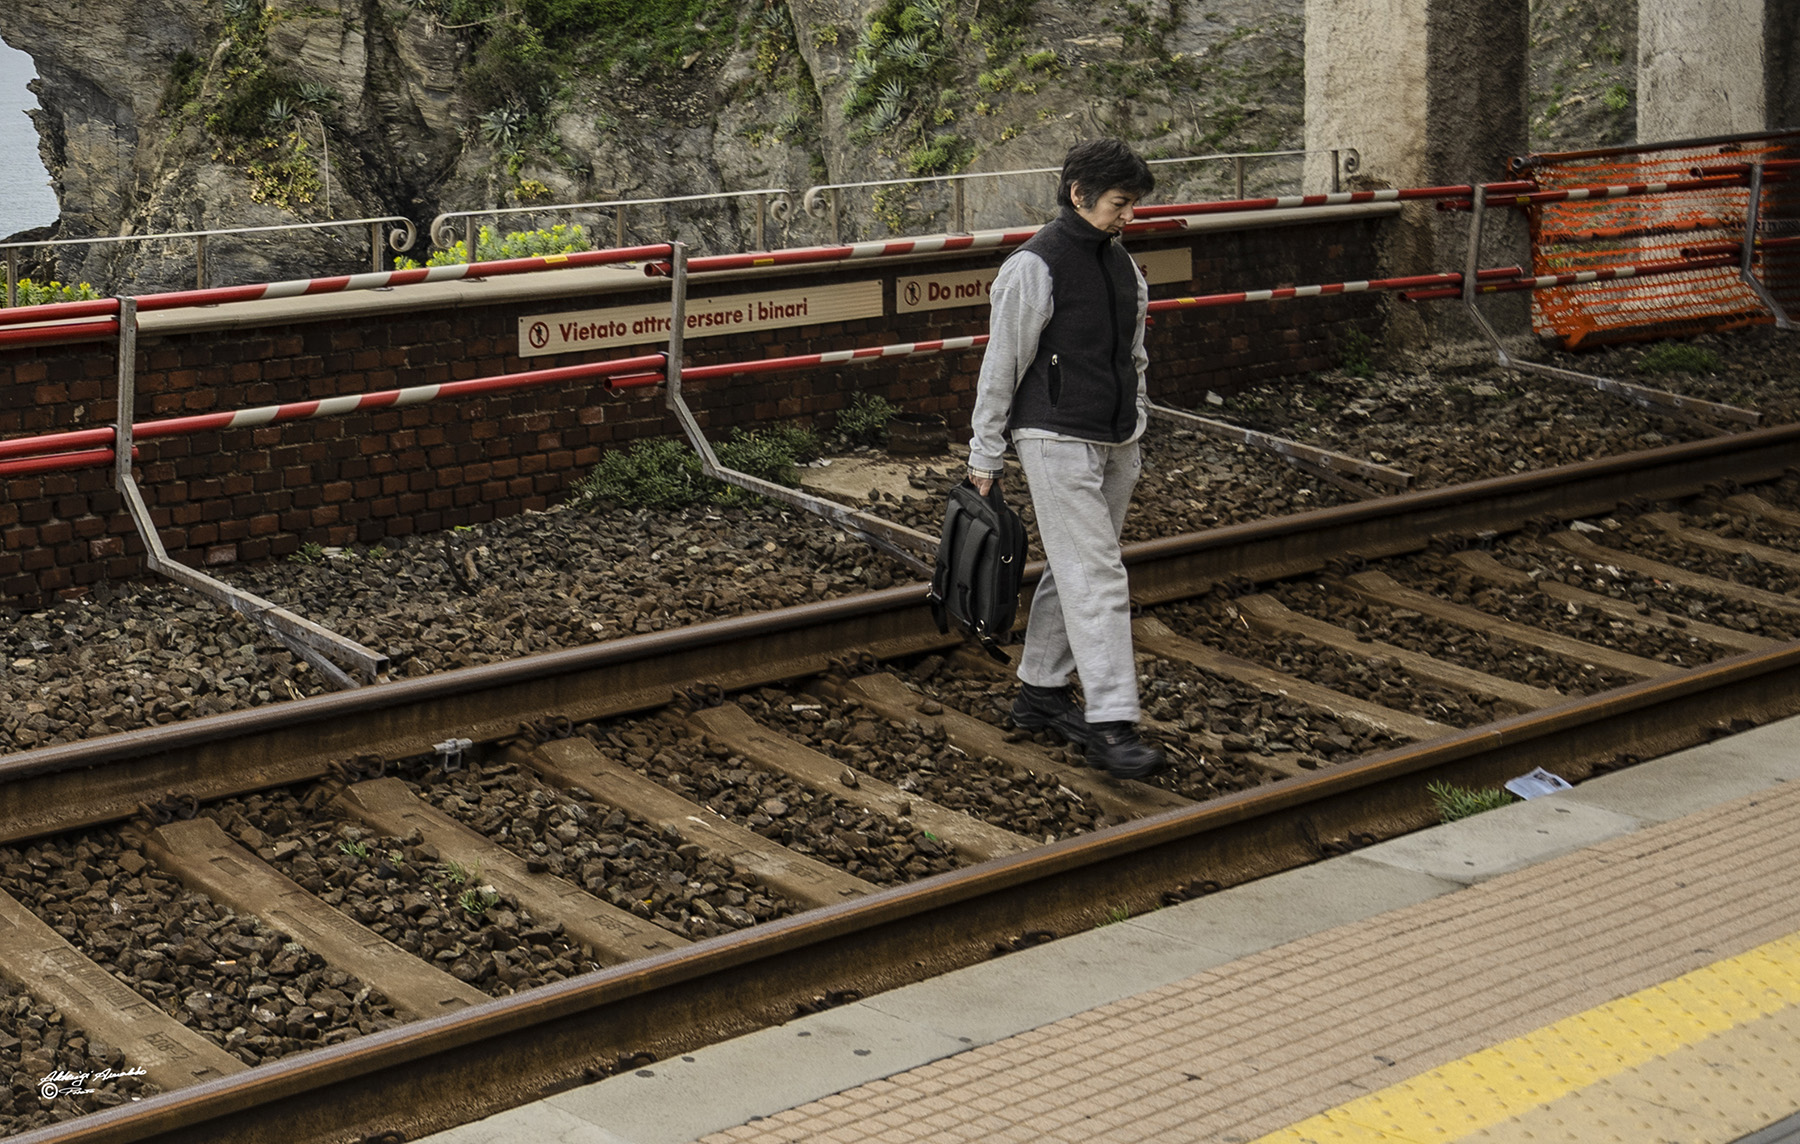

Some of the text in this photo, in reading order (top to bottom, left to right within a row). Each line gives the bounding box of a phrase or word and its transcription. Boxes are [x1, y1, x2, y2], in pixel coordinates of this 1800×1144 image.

[928, 282, 952, 301] Do
[955, 280, 981, 299] not
[559, 297, 808, 342] Vietato attraersare i binari
